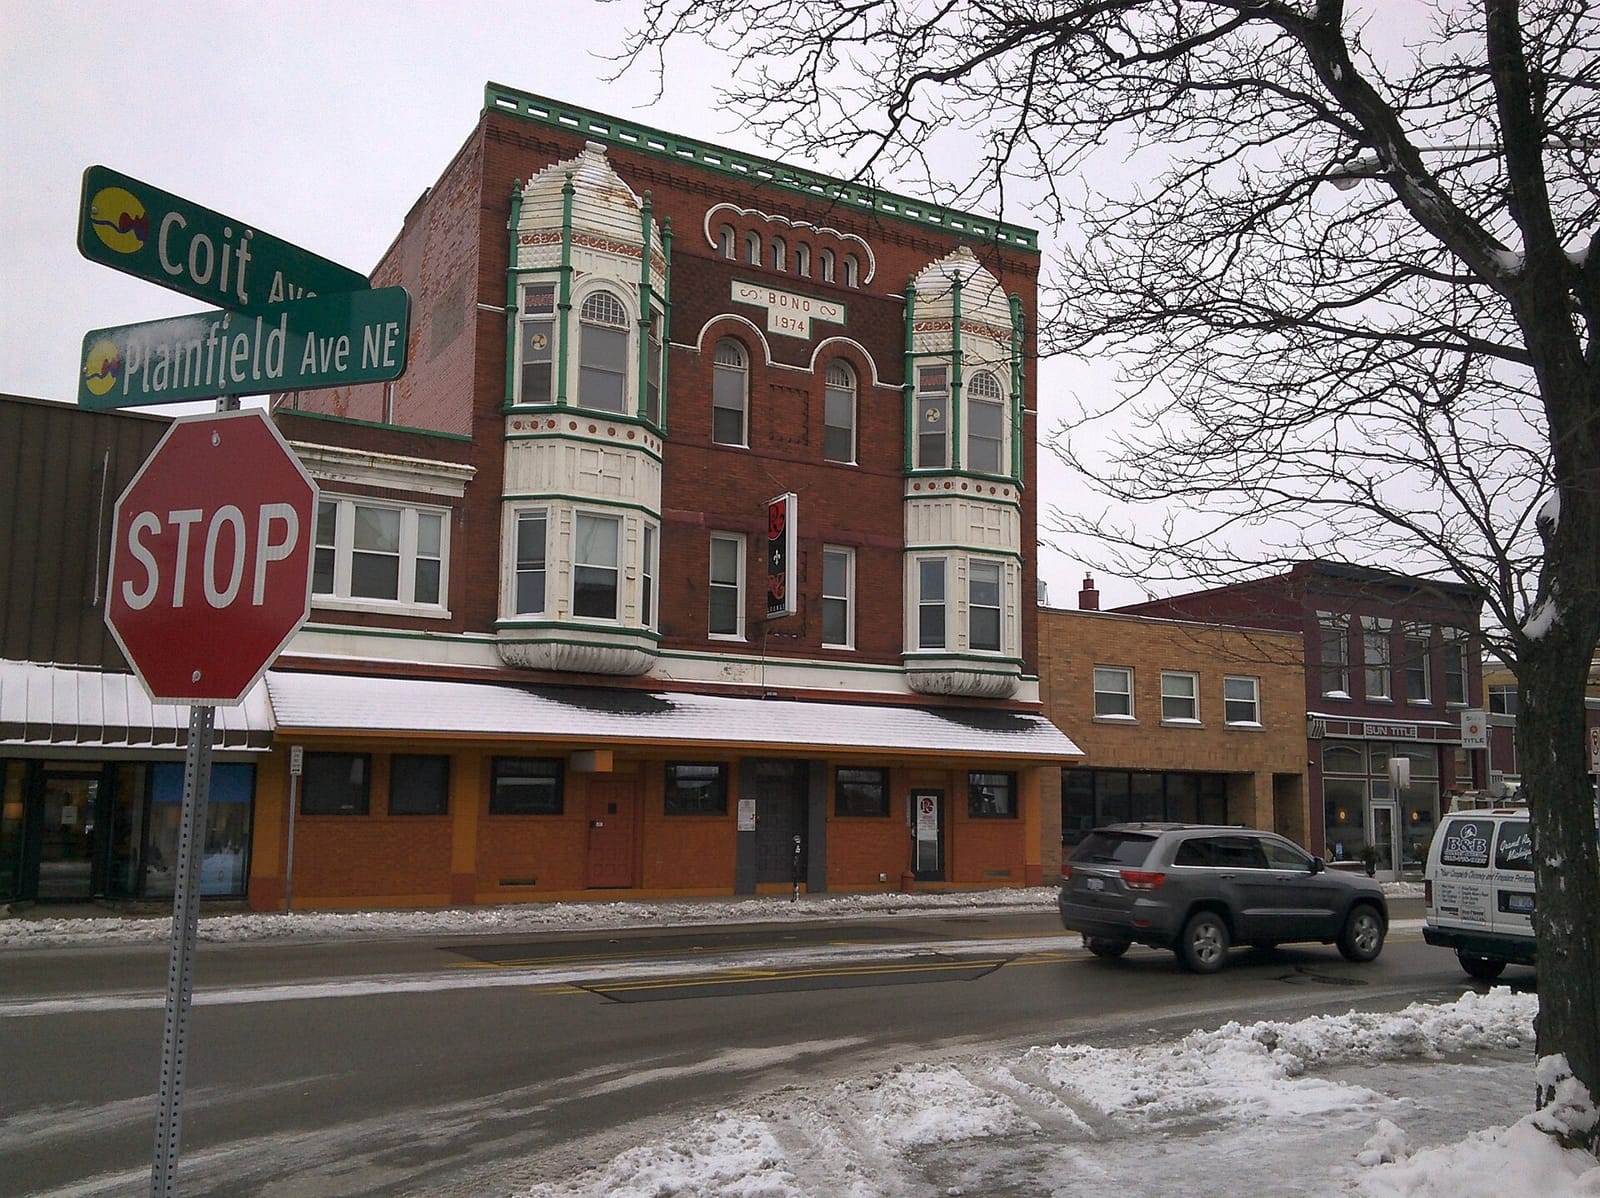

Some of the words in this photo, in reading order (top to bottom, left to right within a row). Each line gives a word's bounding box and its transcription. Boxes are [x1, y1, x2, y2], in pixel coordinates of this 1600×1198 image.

[157, 210, 255, 305] Coit
[268, 271, 317, 303] Av
[768, 291, 810, 312] BONO
[775, 315, 805, 332] 1974
[122, 312, 288, 396] Plainfield
[299, 331, 350, 376] Ave
[361, 322, 398, 370] NE
[122, 502, 299, 611] STOP
[1366, 725, 1388, 736] SUN
[1390, 727, 1417, 738] TITLE
[1447, 836, 1487, 853] B&B
[1500, 835, 1521, 854] Grand
